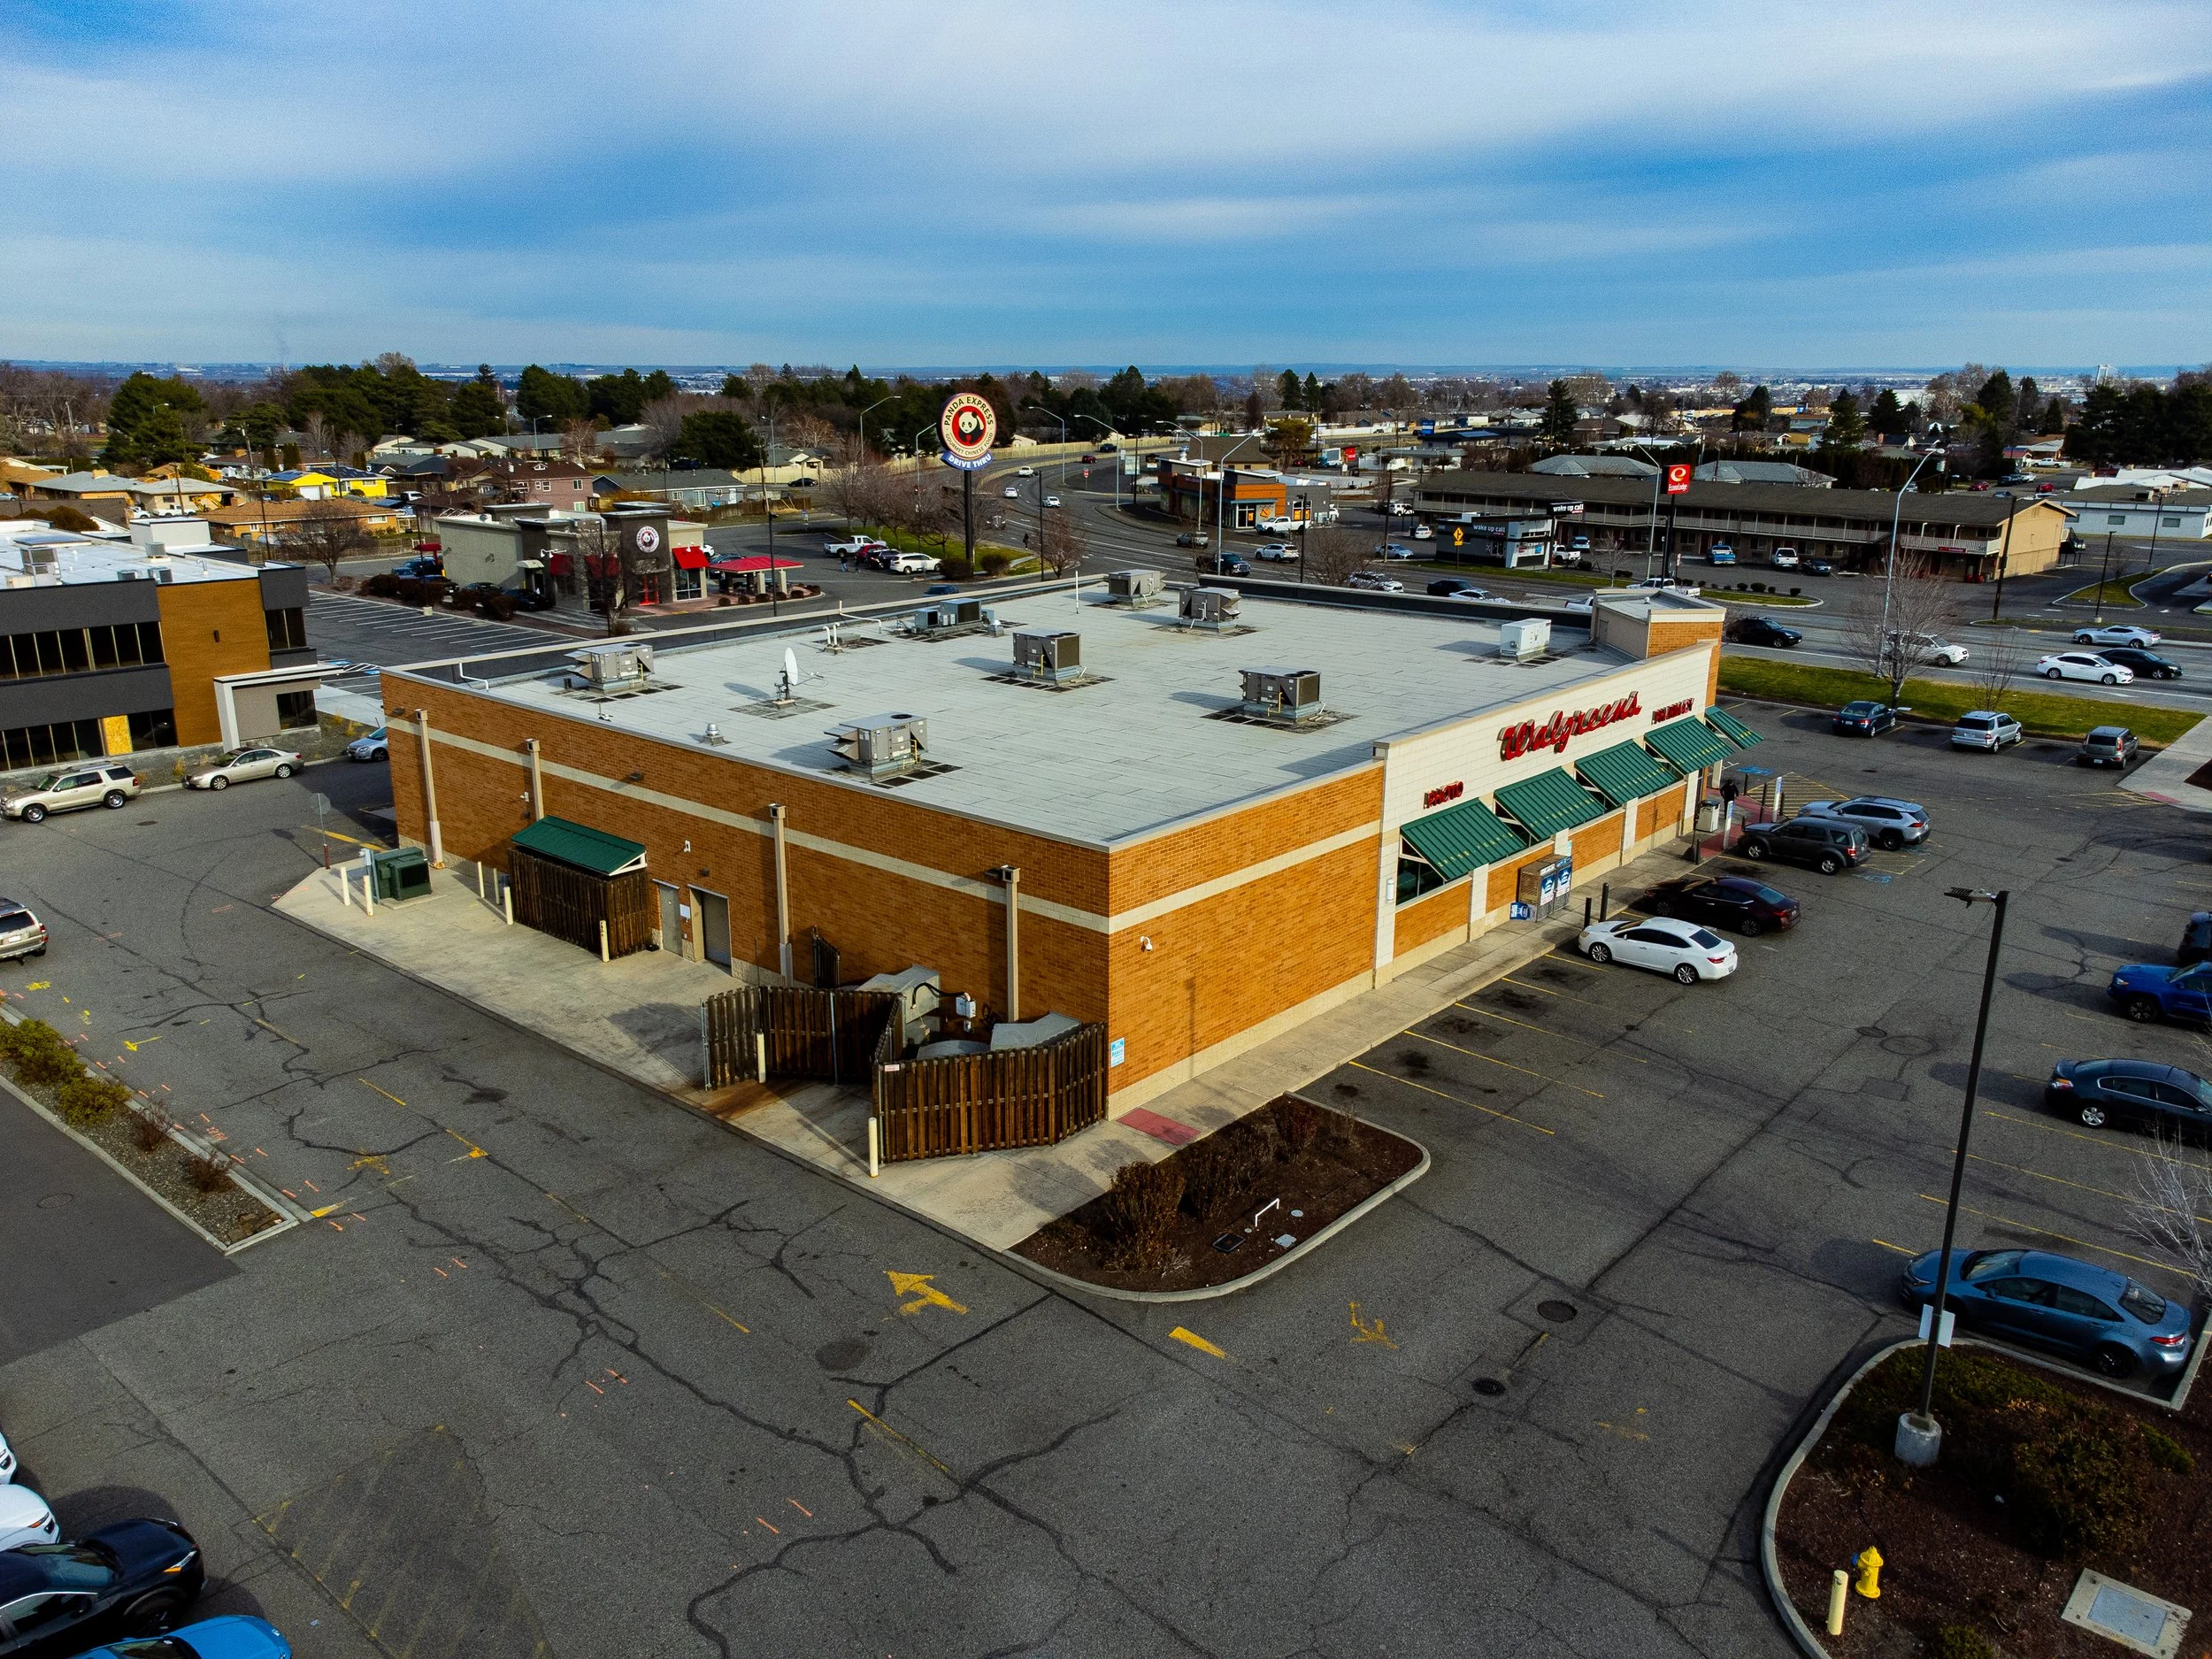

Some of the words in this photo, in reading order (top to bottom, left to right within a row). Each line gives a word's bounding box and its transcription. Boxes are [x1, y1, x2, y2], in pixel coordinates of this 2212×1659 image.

[944, 398, 964, 426] PANDA
[966, 396, 994, 425] EXPRESS
[945, 433, 964, 454] GOURMET
[984, 433, 994, 447] FOOD
[948, 454, 972, 468] DRIVE
[972, 453, 992, 468] THRU
[1496, 690, 1643, 762] Walgreens
[1424, 780, 1463, 809] PHOTO
